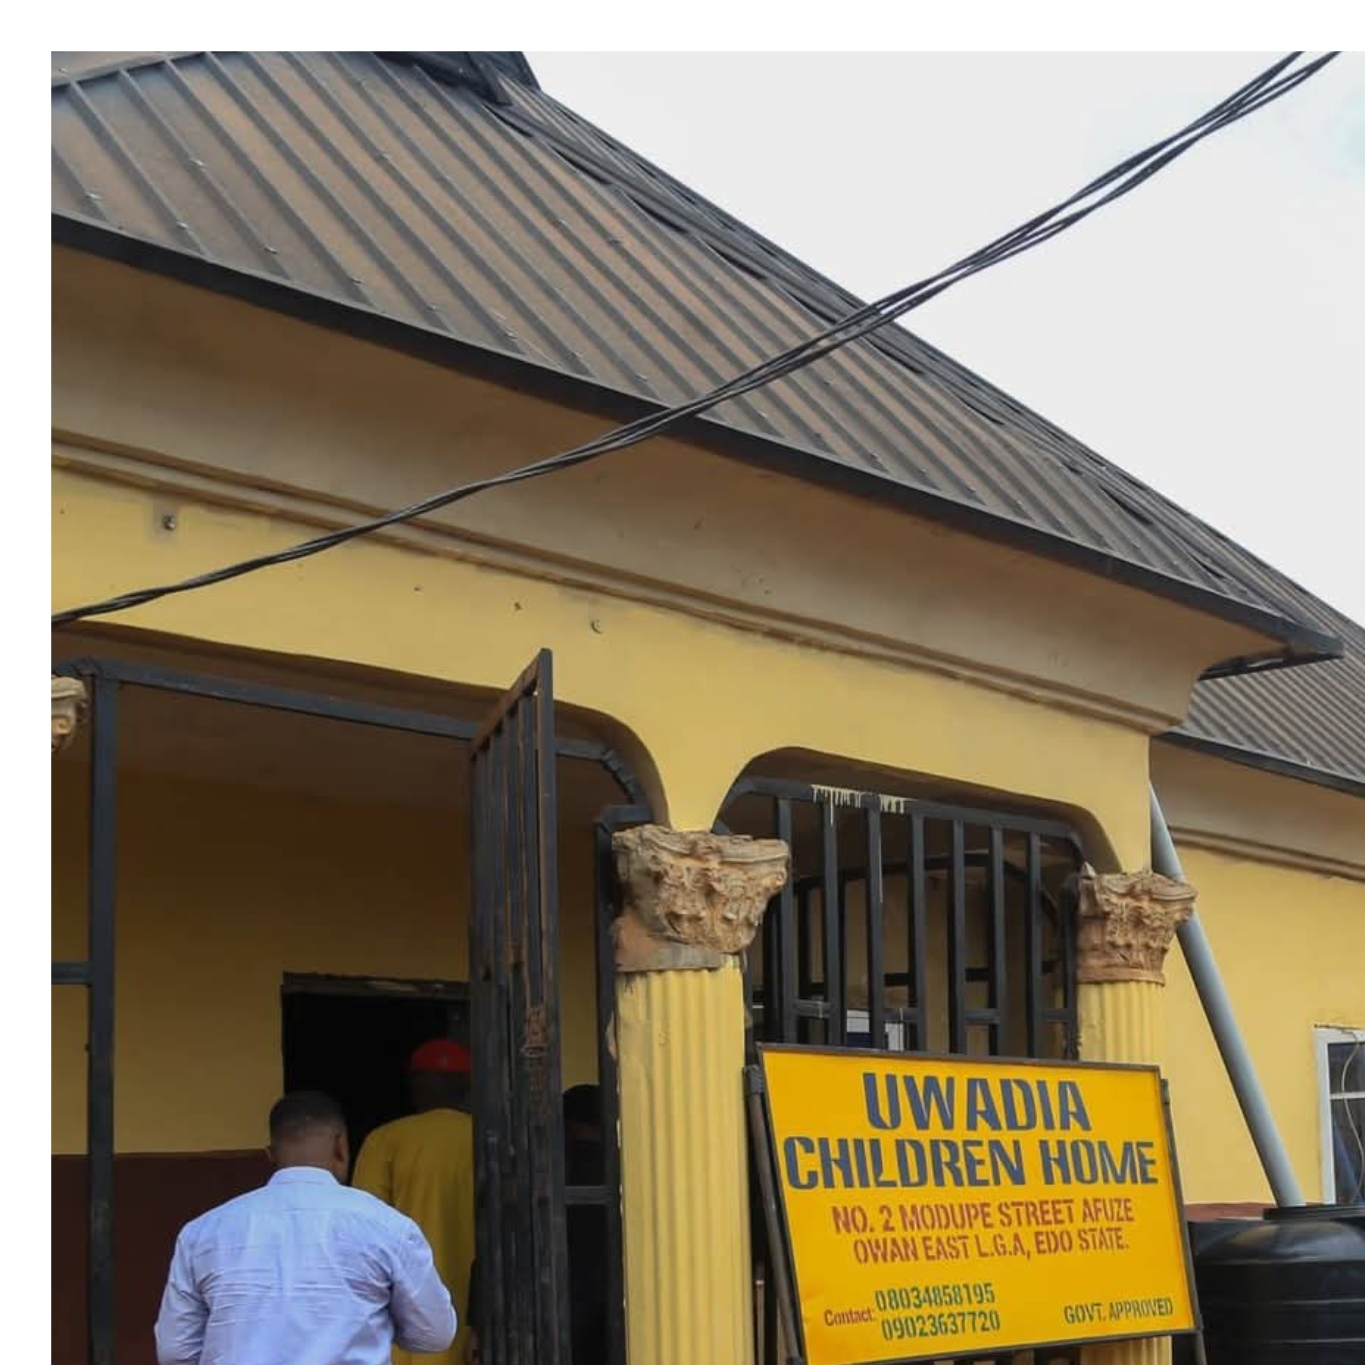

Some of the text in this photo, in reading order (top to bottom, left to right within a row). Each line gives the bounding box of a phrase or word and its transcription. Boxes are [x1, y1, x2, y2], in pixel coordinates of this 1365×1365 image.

[862, 1072, 1092, 1132] UWADIA
[782, 1136, 1159, 1190] CHILDREN HOME
[831, 1197, 1135, 1234] NO. 2 MODUPE STREET AFUZE
[853, 1227, 1129, 1265] OWAN EAST L.G.A, EDO STATE.
[874, 1282, 995, 1312] 08034858195
[1063, 1297, 1174, 1325] GOVT. APPROVED
[823, 1307, 876, 1327] Contact:
[881, 1310, 1001, 1341] 09023637720
